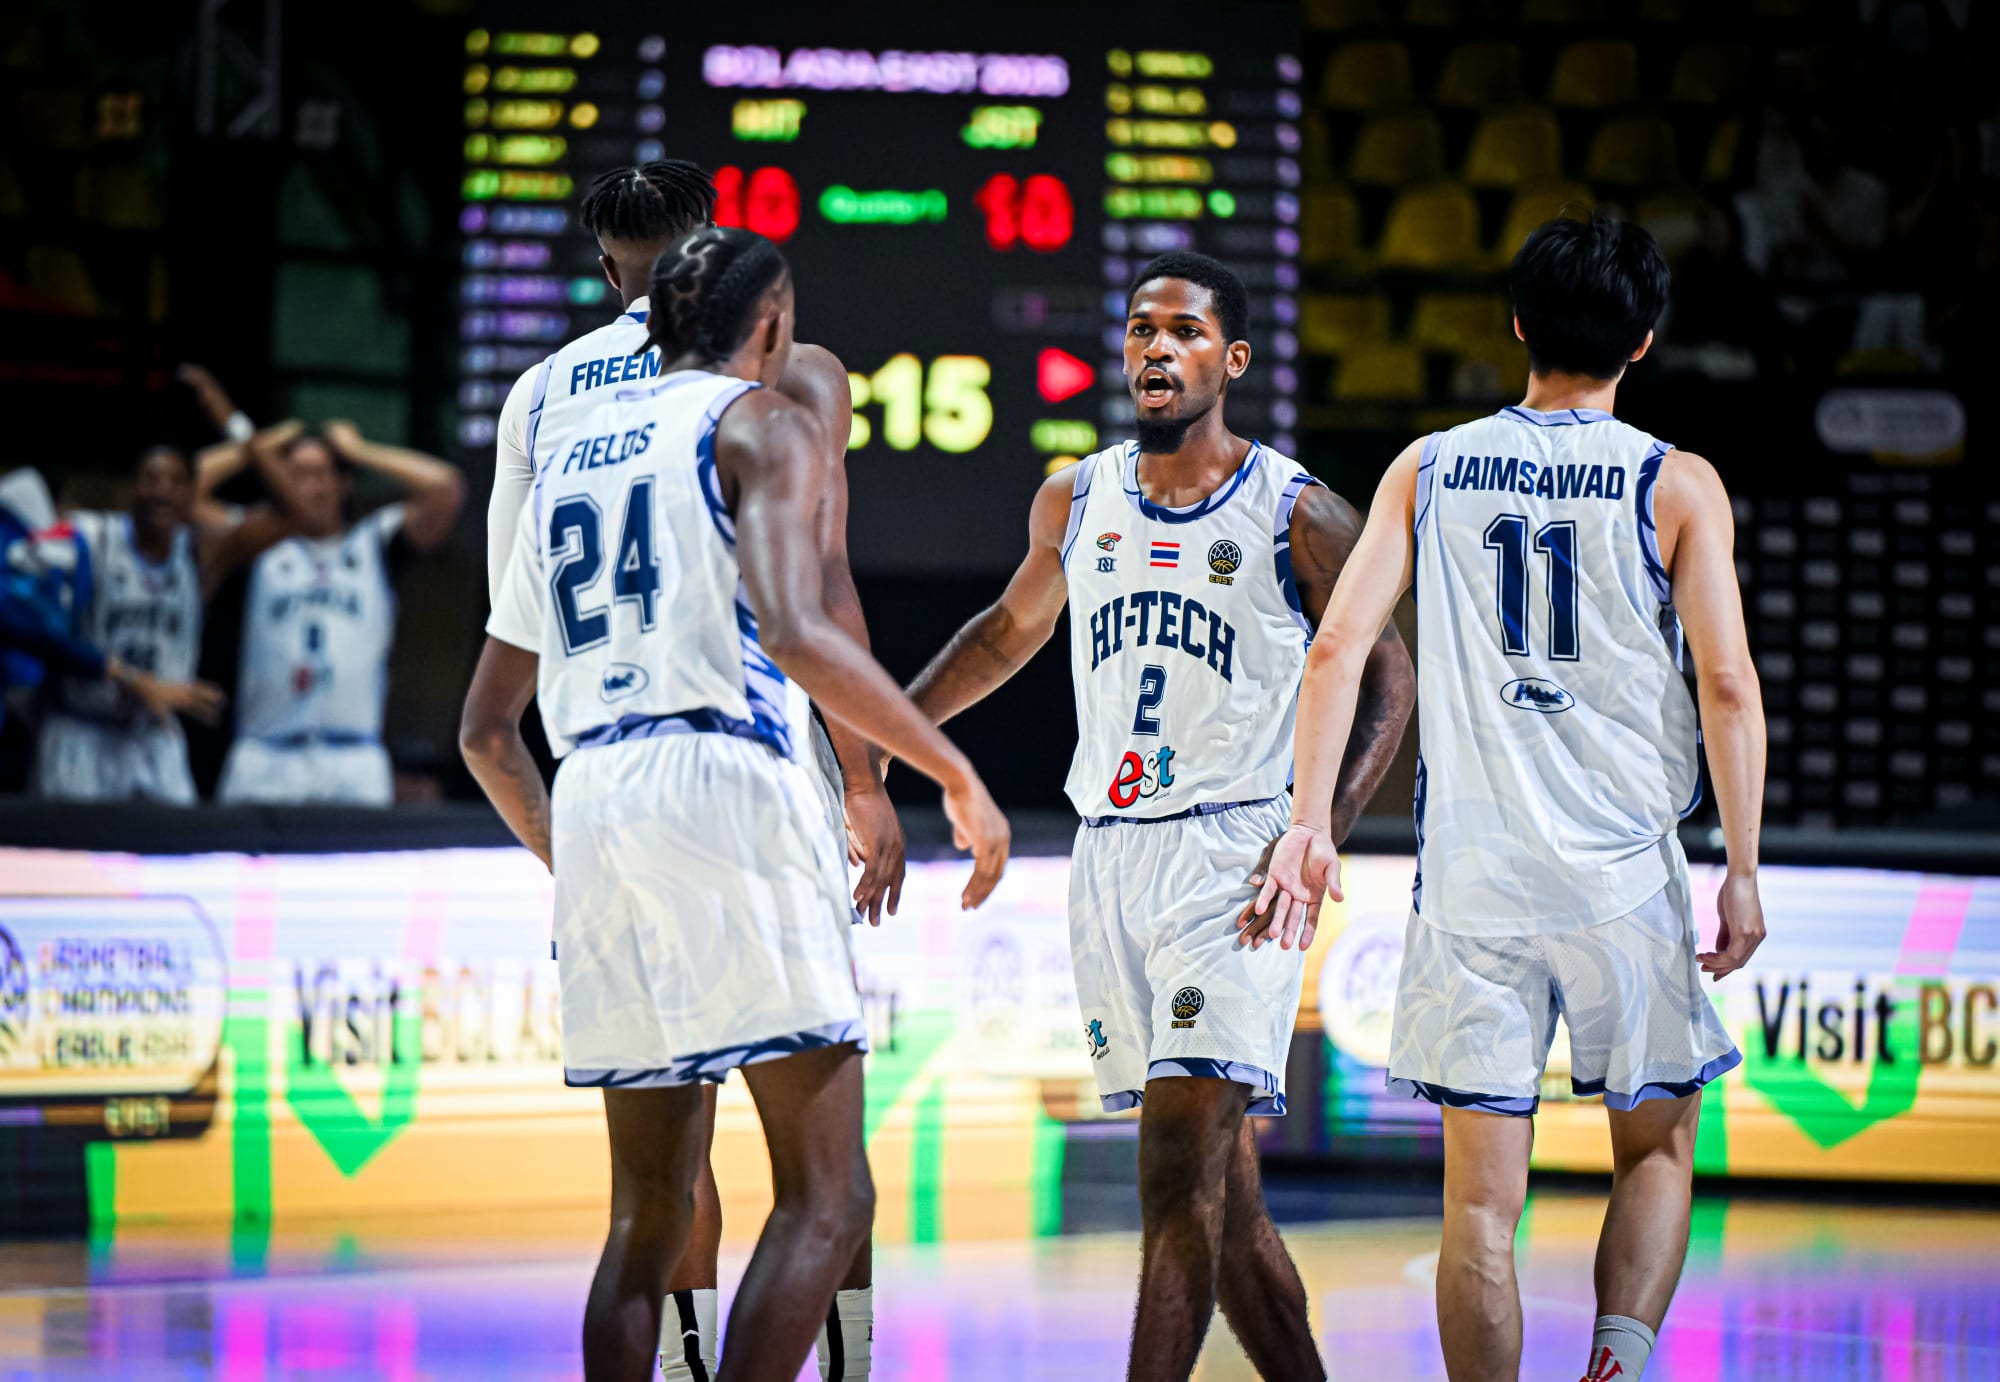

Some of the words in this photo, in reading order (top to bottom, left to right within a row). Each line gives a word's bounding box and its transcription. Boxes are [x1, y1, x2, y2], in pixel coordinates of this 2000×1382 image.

[562, 422, 656, 475] FIELDS
[1443, 455, 1626, 501] JAIMSAWAD
[550, 475, 662, 657] 24
[1208, 573, 1235, 586] EAST
[1483, 512, 1580, 662] 11
[1090, 590, 1236, 685] HI-TECH
[1131, 664, 1167, 736] 2
[1108, 745, 1176, 809] est
[1171, 1019, 1197, 1029] EAST
[1756, 976, 1896, 1065] Visit
